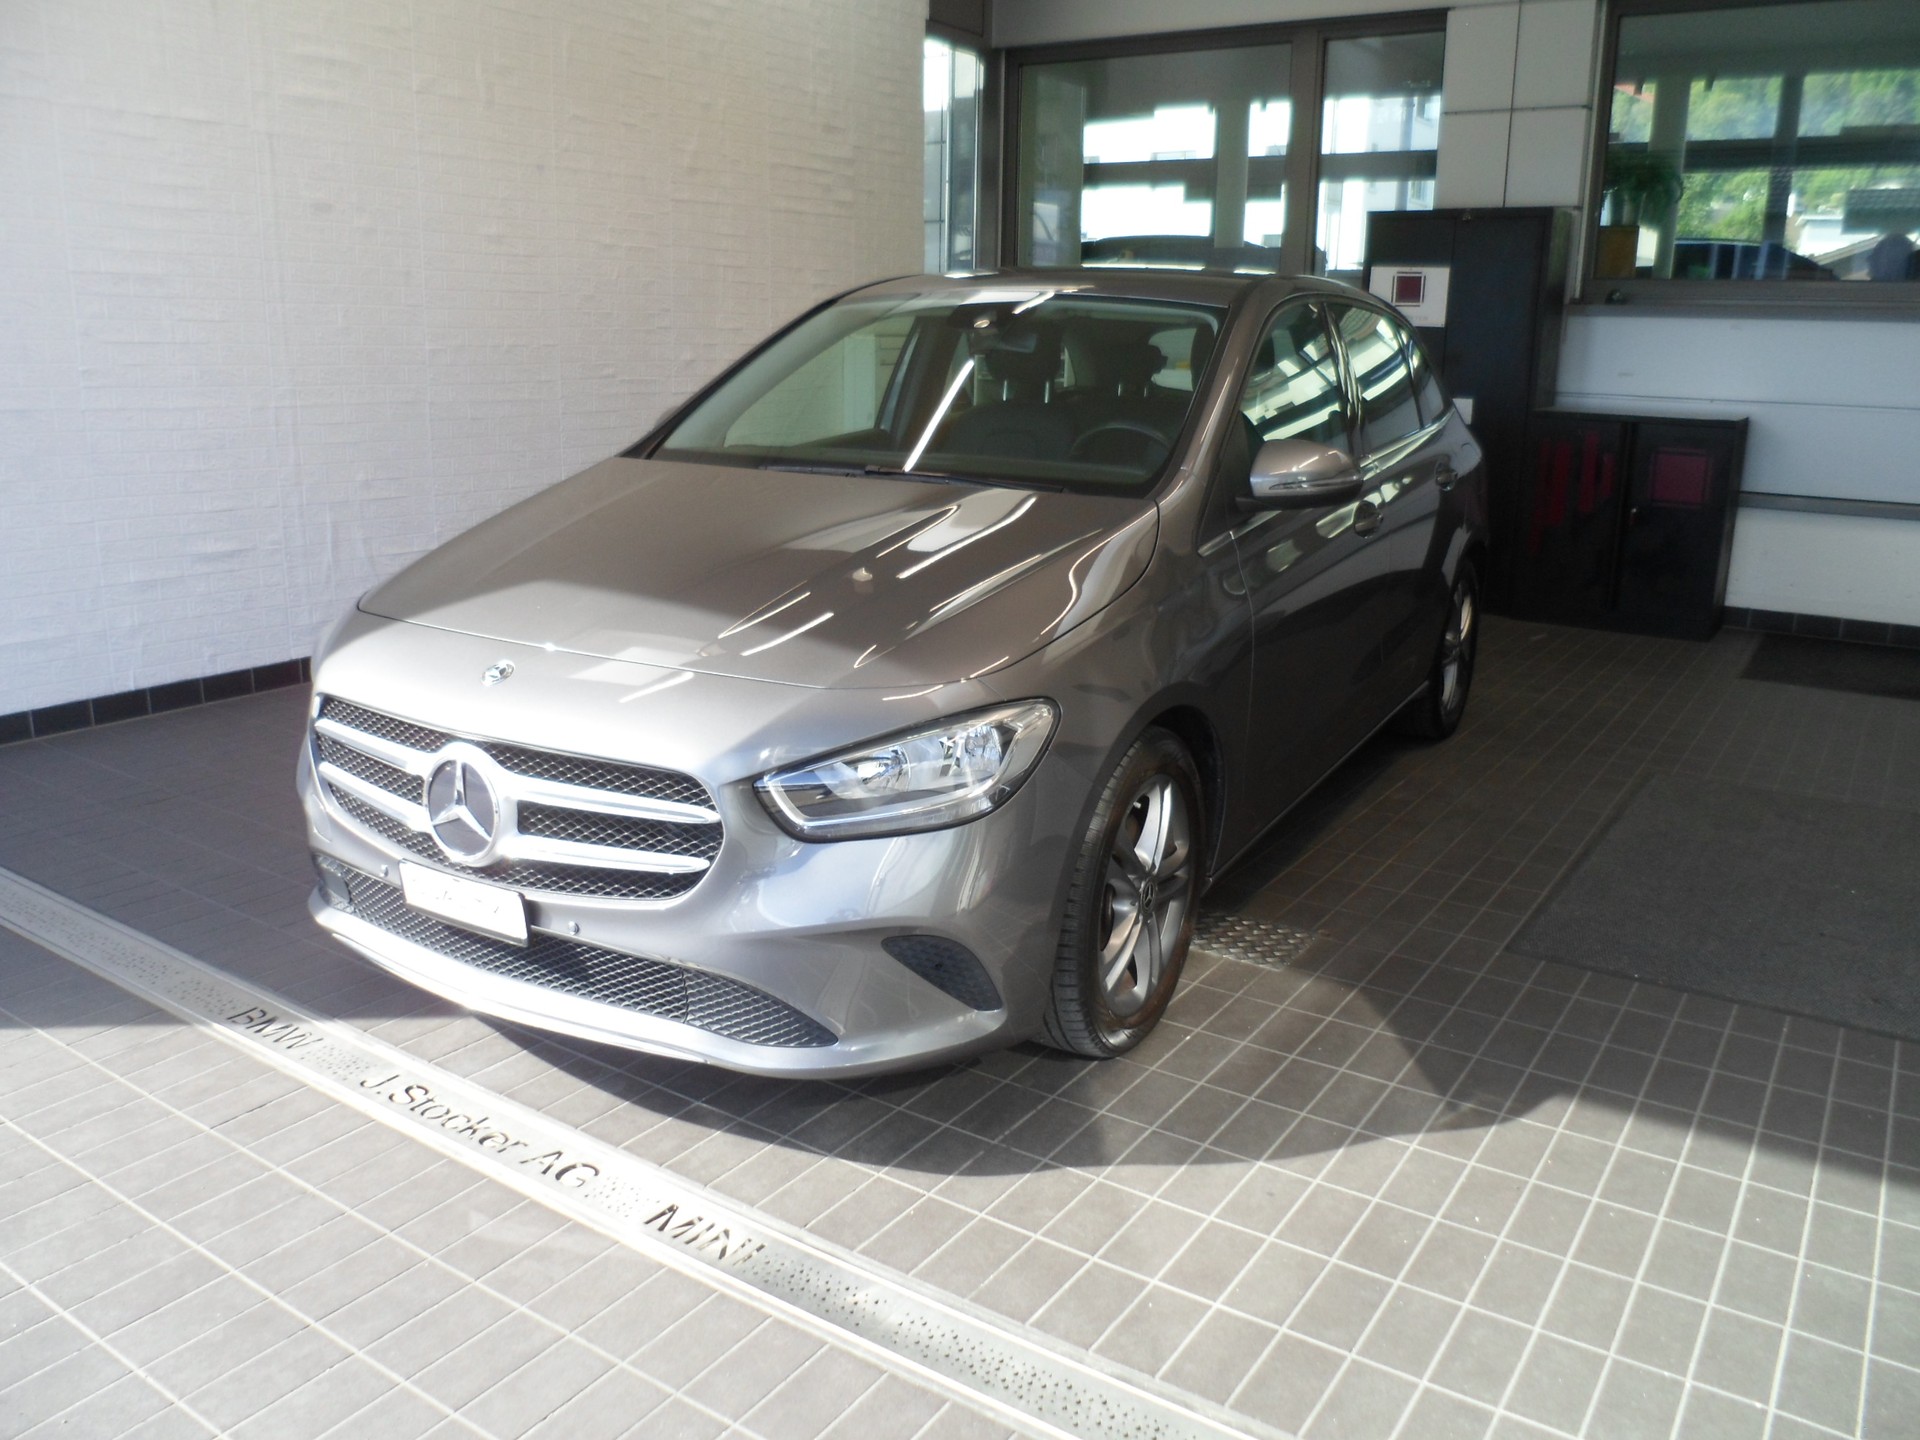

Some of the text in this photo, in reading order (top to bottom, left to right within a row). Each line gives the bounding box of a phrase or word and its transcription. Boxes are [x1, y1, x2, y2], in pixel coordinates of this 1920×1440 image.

[226, 1006, 324, 1049] BMW
[519, 1150, 600, 1188] AG
[643, 1203, 767, 1267] MINI
